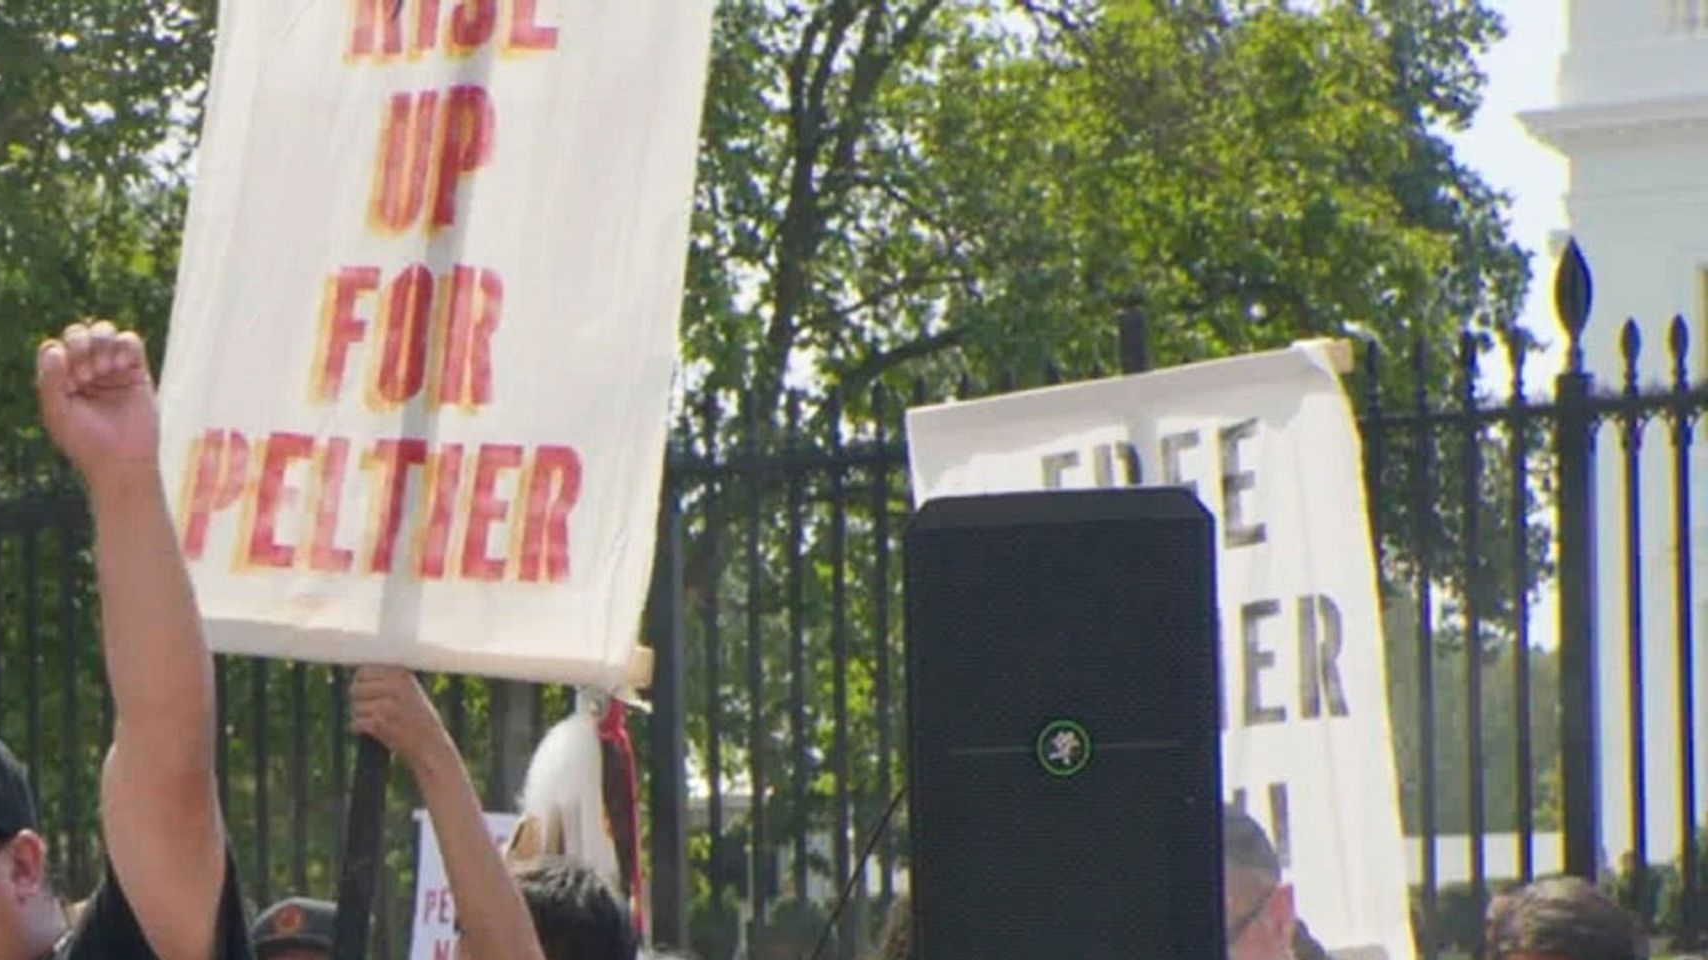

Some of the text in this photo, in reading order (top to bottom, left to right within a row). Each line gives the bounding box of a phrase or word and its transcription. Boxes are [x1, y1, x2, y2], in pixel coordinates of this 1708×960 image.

[366, 84, 496, 236] UP
[310, 263, 504, 412] FOR
[180, 428, 583, 585] PELTIER
